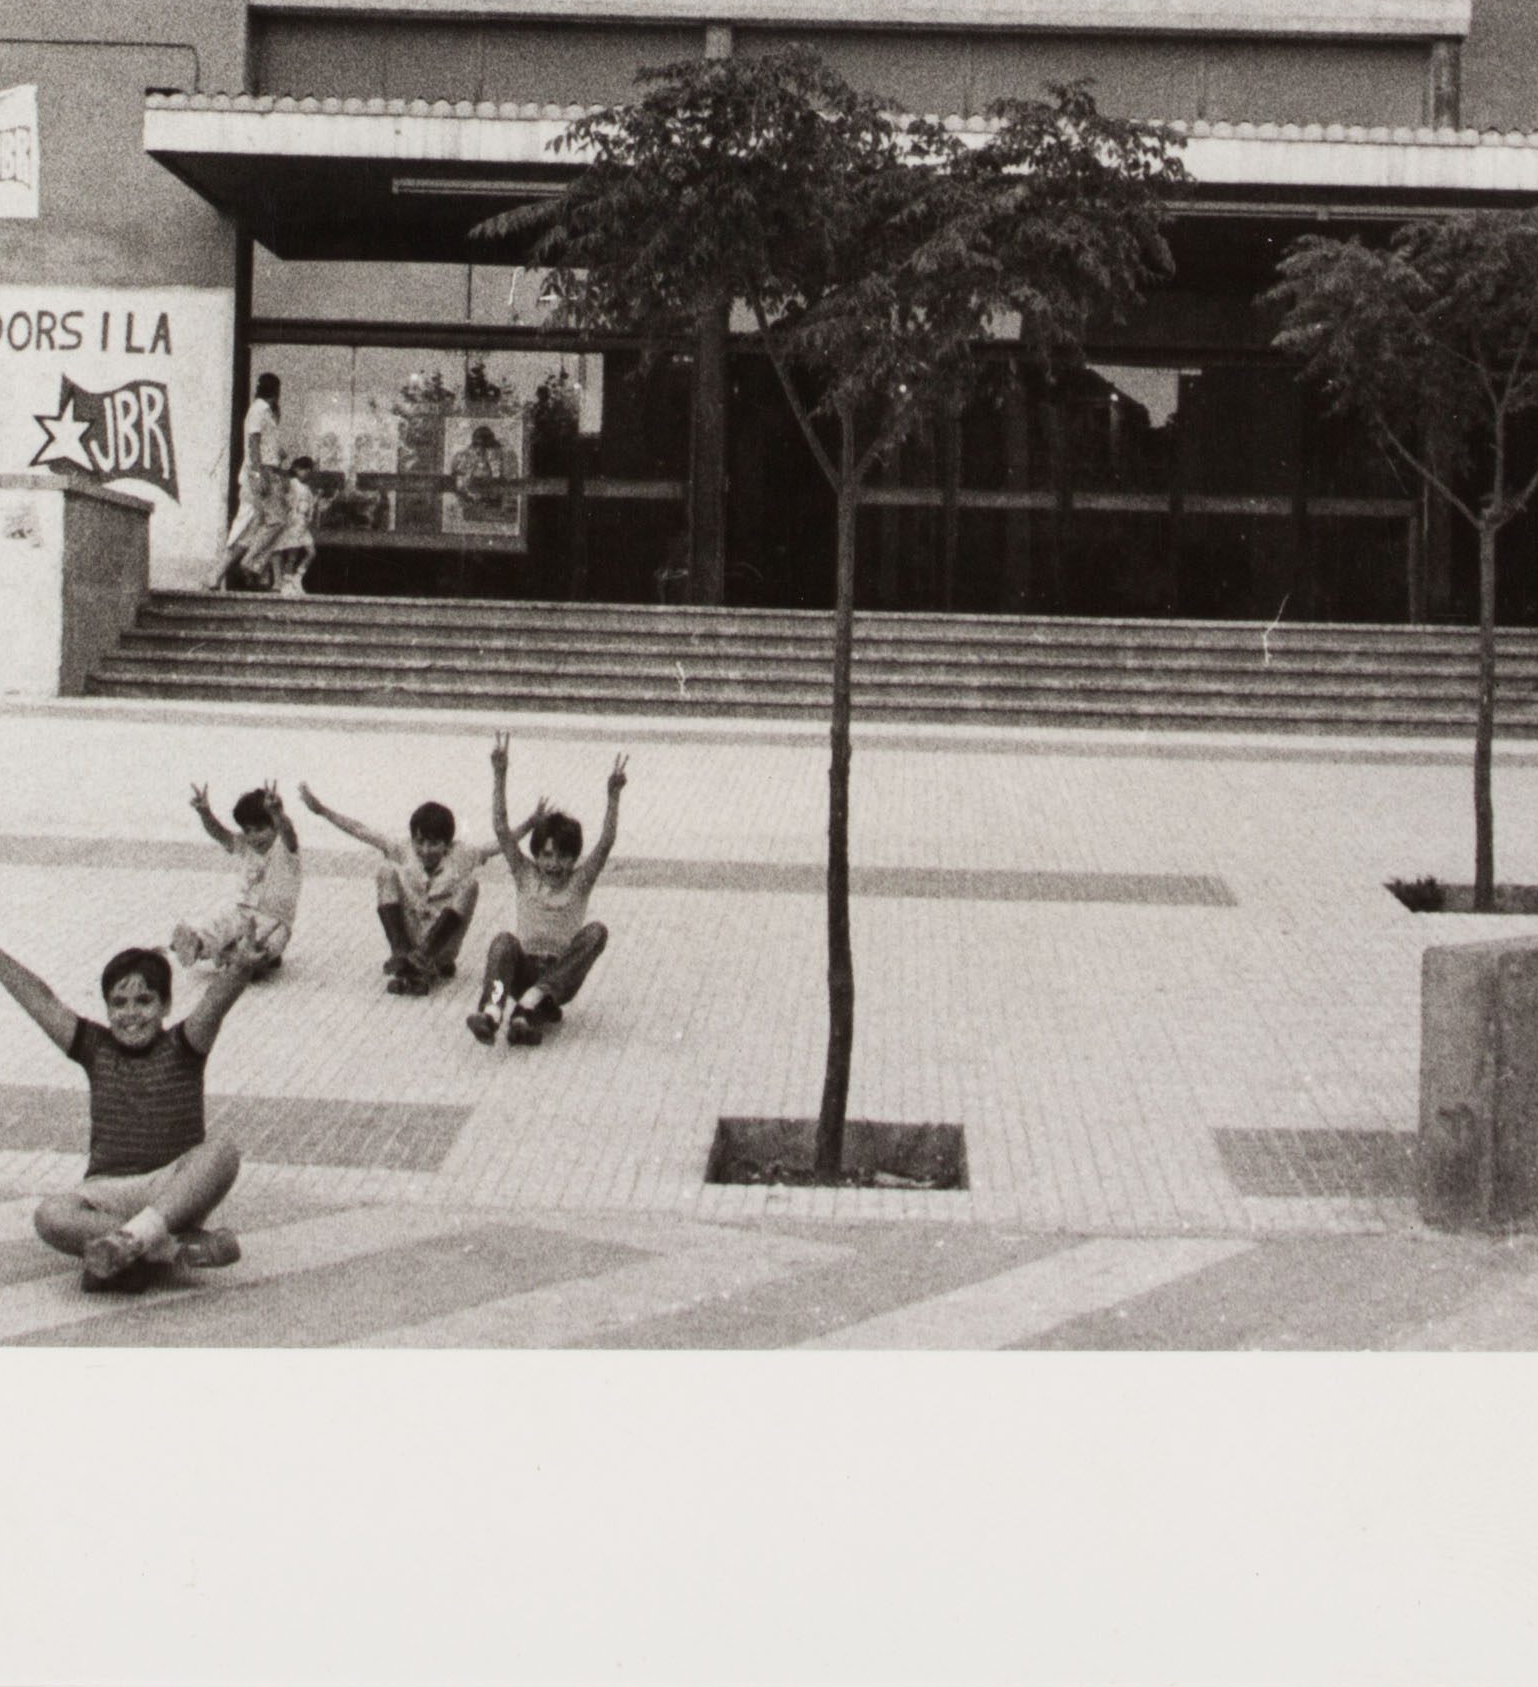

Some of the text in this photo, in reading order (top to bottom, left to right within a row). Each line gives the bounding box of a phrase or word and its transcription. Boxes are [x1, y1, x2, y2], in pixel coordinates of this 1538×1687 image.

[100, 311, 111, 353] I
[124, 311, 174, 356] LA
[89, 384, 171, 480] JBR
